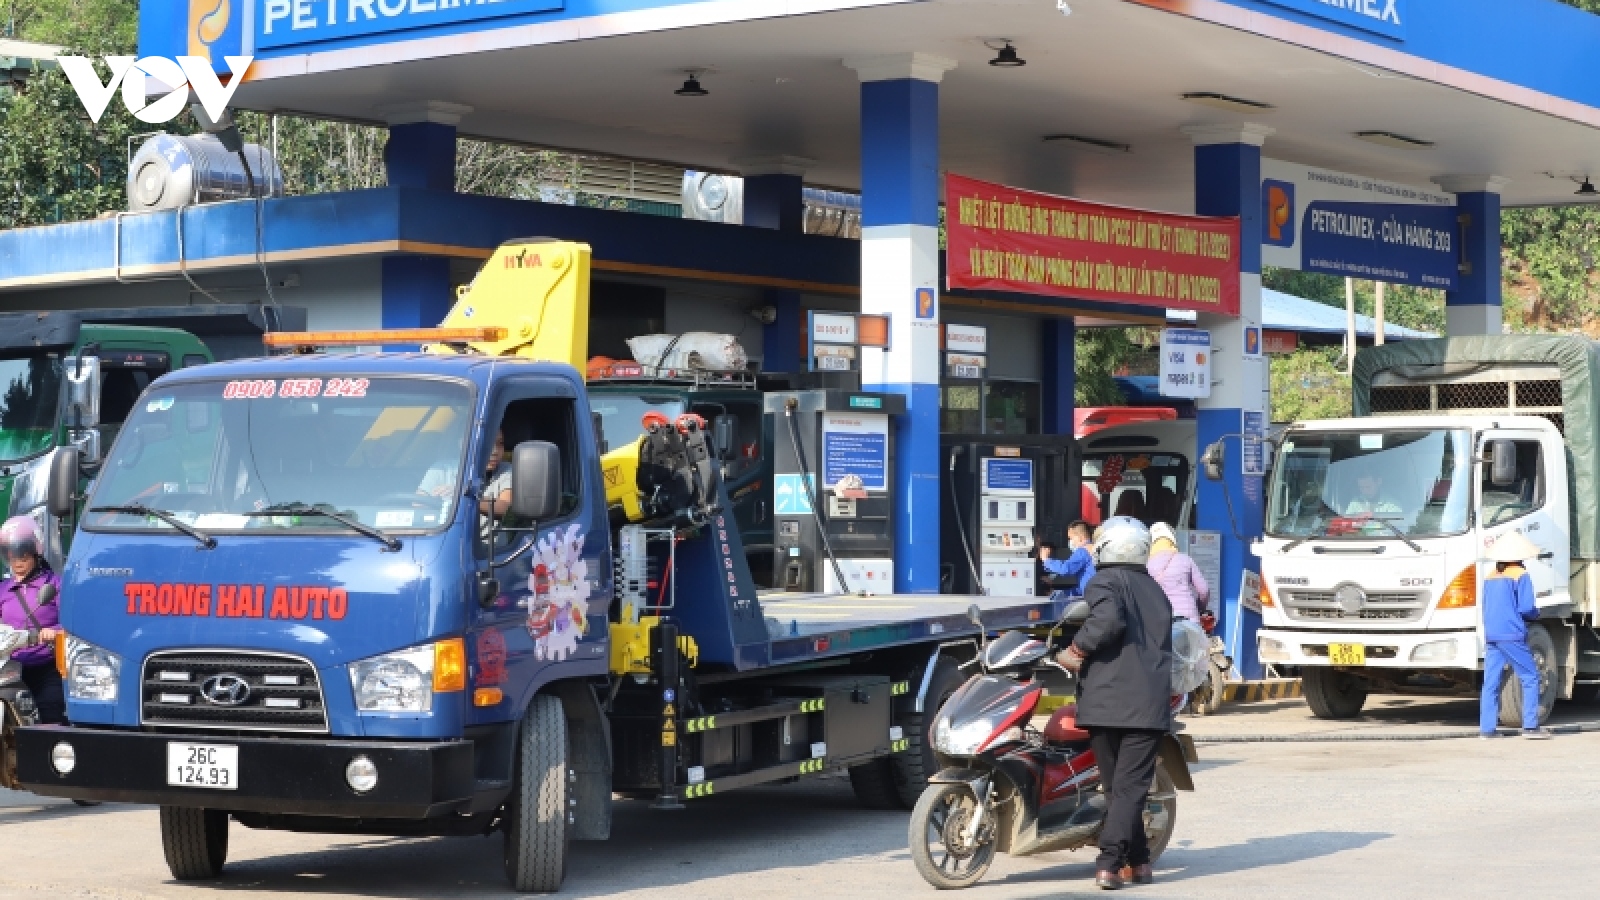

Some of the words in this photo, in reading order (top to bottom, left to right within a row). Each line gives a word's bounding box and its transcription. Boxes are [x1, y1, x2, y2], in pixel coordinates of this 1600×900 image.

[1311, 208, 1375, 240] PETROLIMEX
[1382, 213, 1404, 245] CỬA
[1405, 219, 1433, 250] HÀNG
[504, 248, 542, 269] HYVA
[223, 379, 277, 400] 0904
[278, 377, 323, 399] 858
[323, 377, 371, 399] 242
[1400, 577, 1433, 587] 500
[123, 582, 211, 617] TRONG
[216, 583, 265, 619] HAI
[270, 585, 348, 620] AUTO
[187, 746, 217, 764] 26C
[177, 765, 229, 786] 124.93
